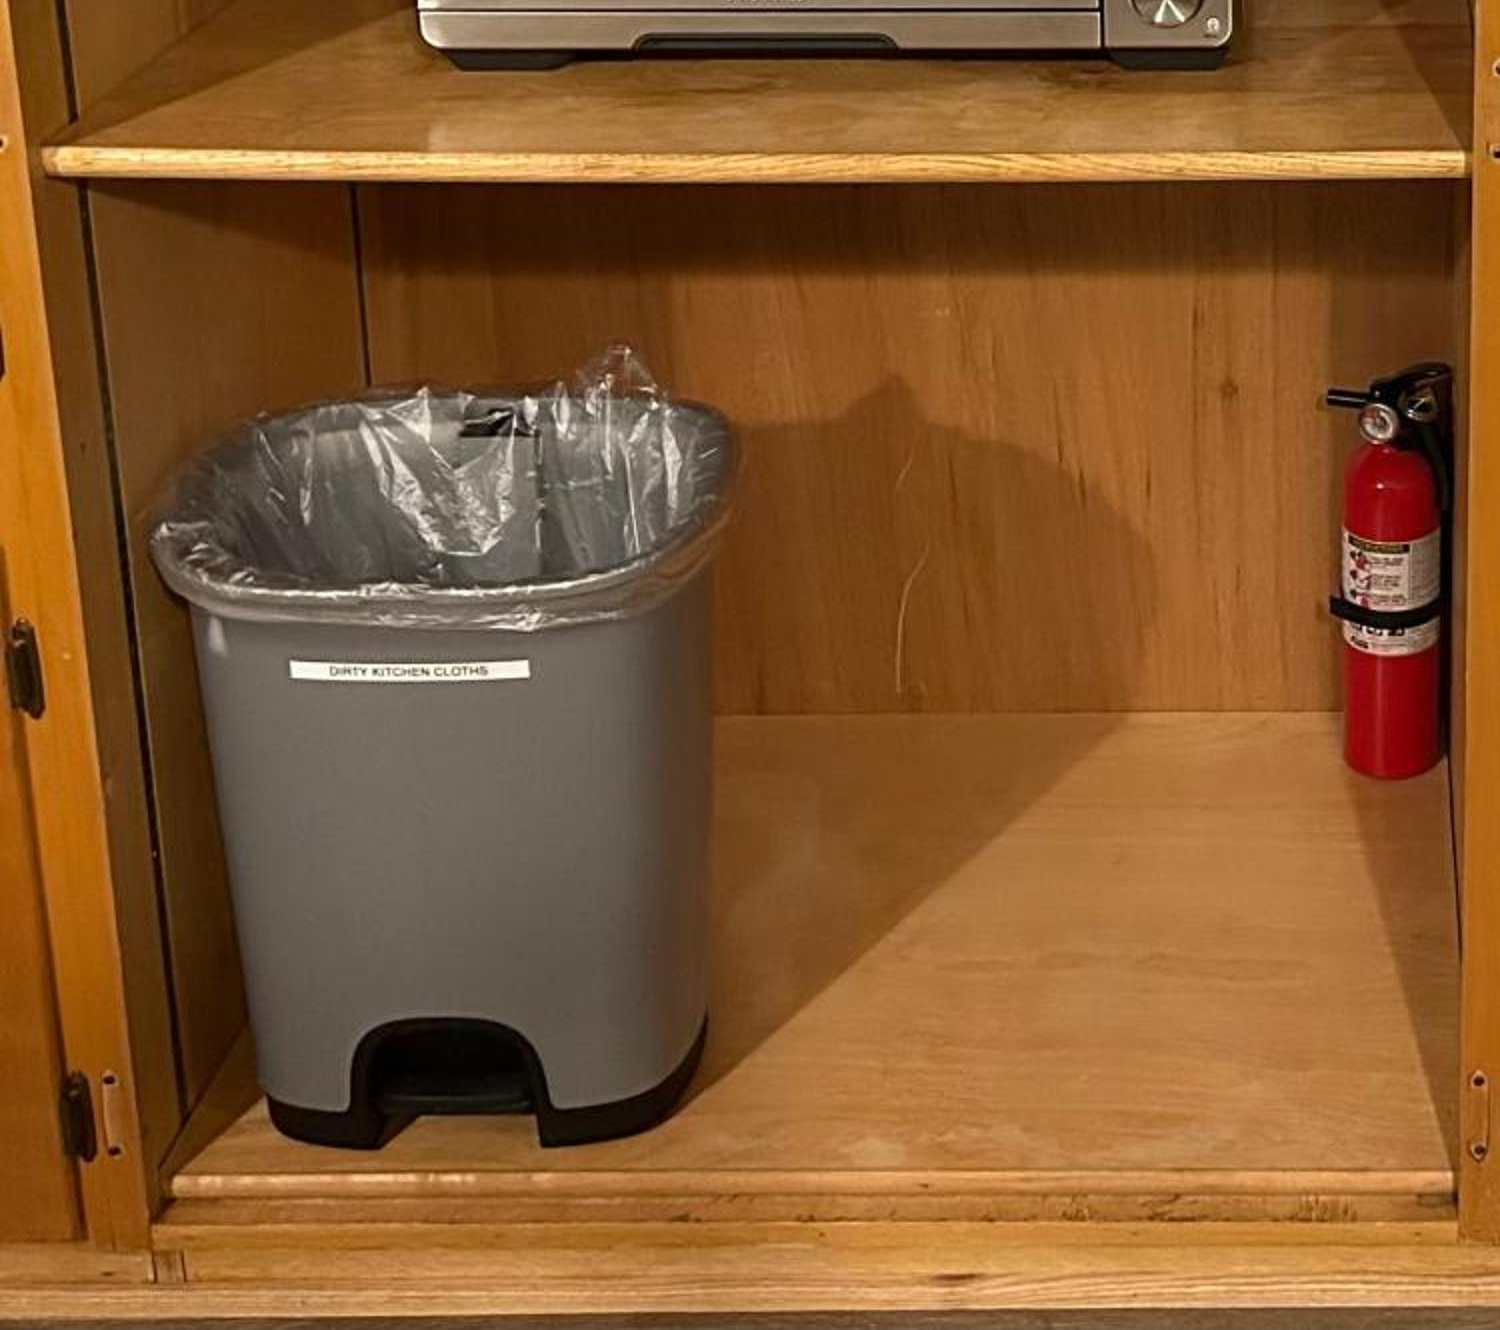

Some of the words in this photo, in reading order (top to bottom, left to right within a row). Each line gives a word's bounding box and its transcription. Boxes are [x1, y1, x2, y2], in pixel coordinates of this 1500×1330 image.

[329, 665, 368, 677] DIRTY
[372, 666, 431, 677] KITCHEN
[433, 664, 489, 677] CLOTHS
